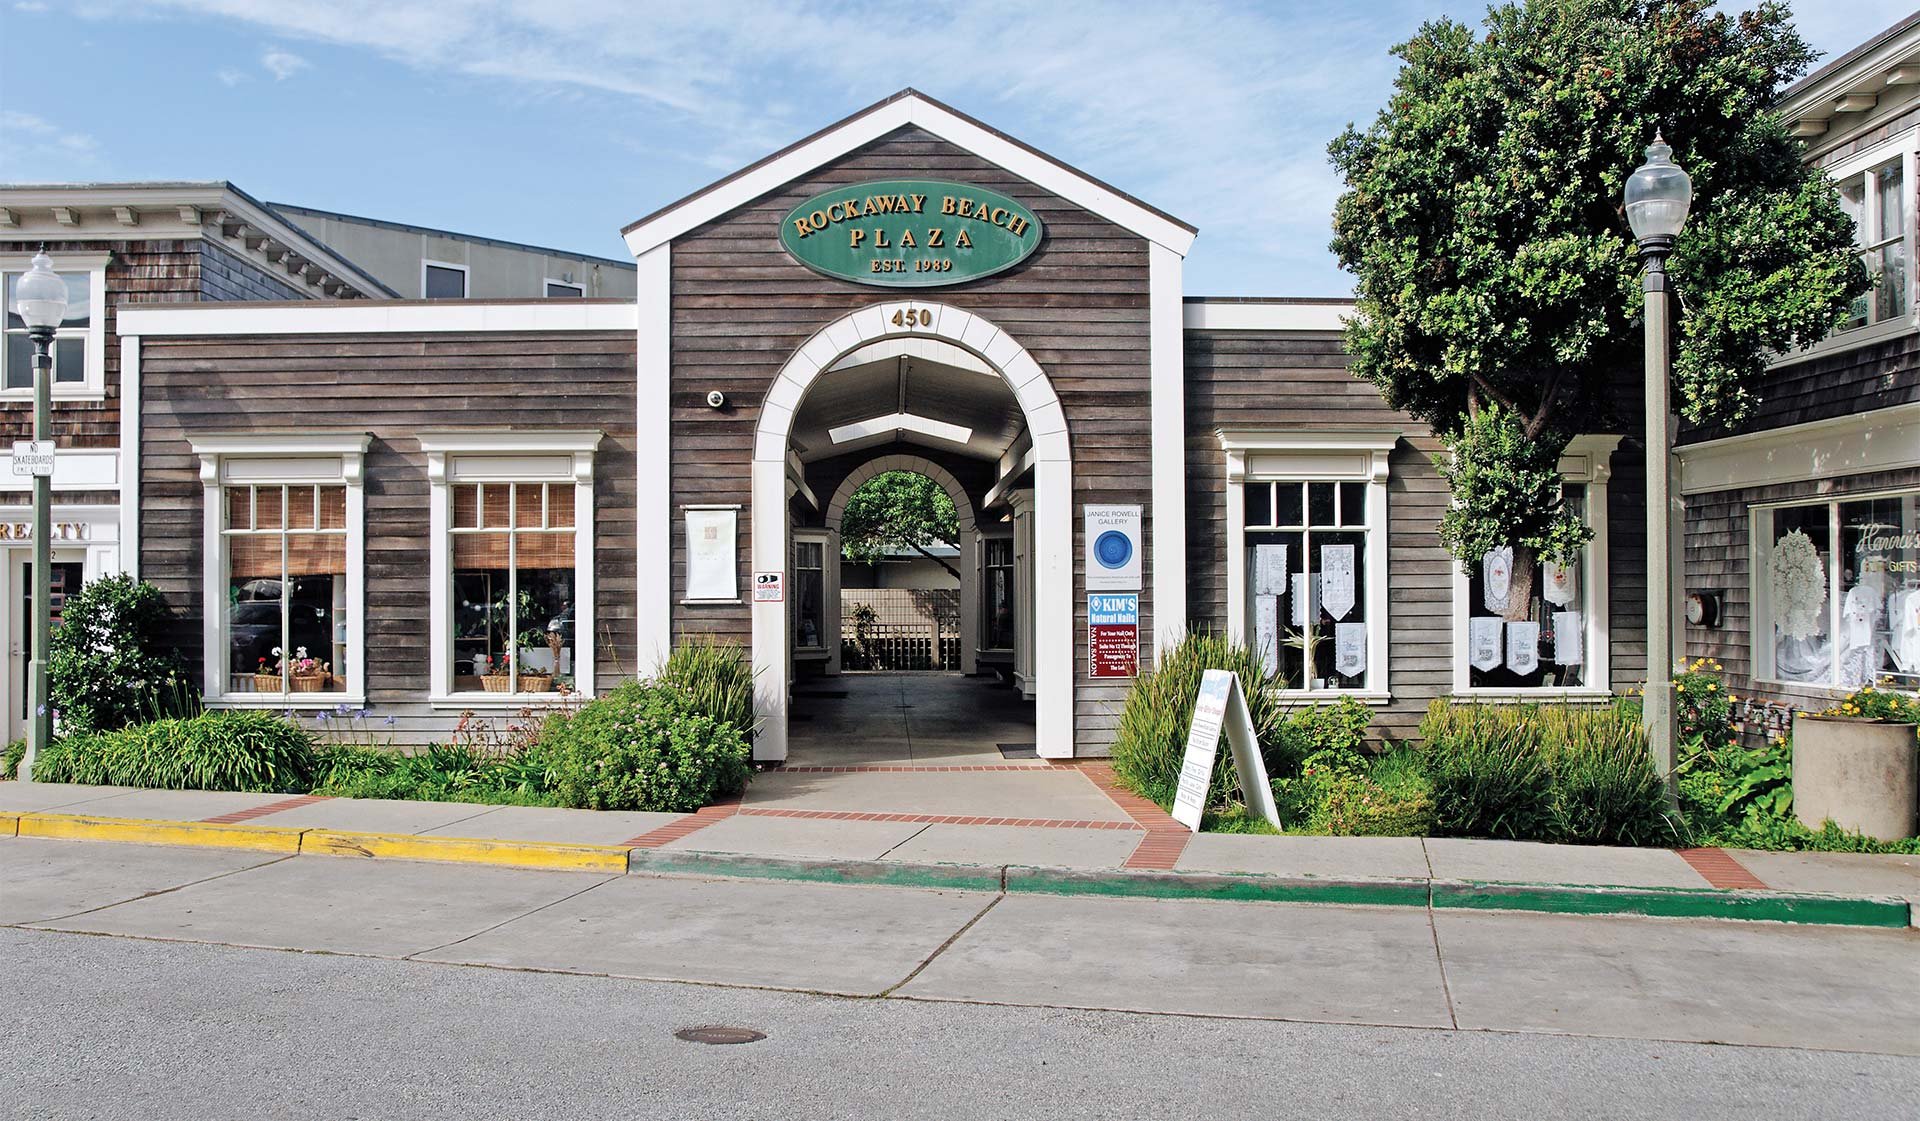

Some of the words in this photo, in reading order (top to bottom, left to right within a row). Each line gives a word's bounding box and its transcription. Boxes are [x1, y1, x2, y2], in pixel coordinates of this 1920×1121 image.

[793, 193, 928, 240] ROCKAWAY
[941, 195, 1031, 238] BEACH
[850, 228, 974, 248] PLAZA
[870, 259, 906, 273] EST.
[914, 259, 953, 273] 1989
[891, 308, 932, 327] 450
[30, 444, 39, 453] NO
[14, 455, 53, 465] SKATEBOARDS
[1889, 561, 1917, 573] GIFTS
[1102, 598, 1136, 612] KIM'S
[1091, 613, 1117, 623] Natural
[1118, 613, 1135, 623] Nails
